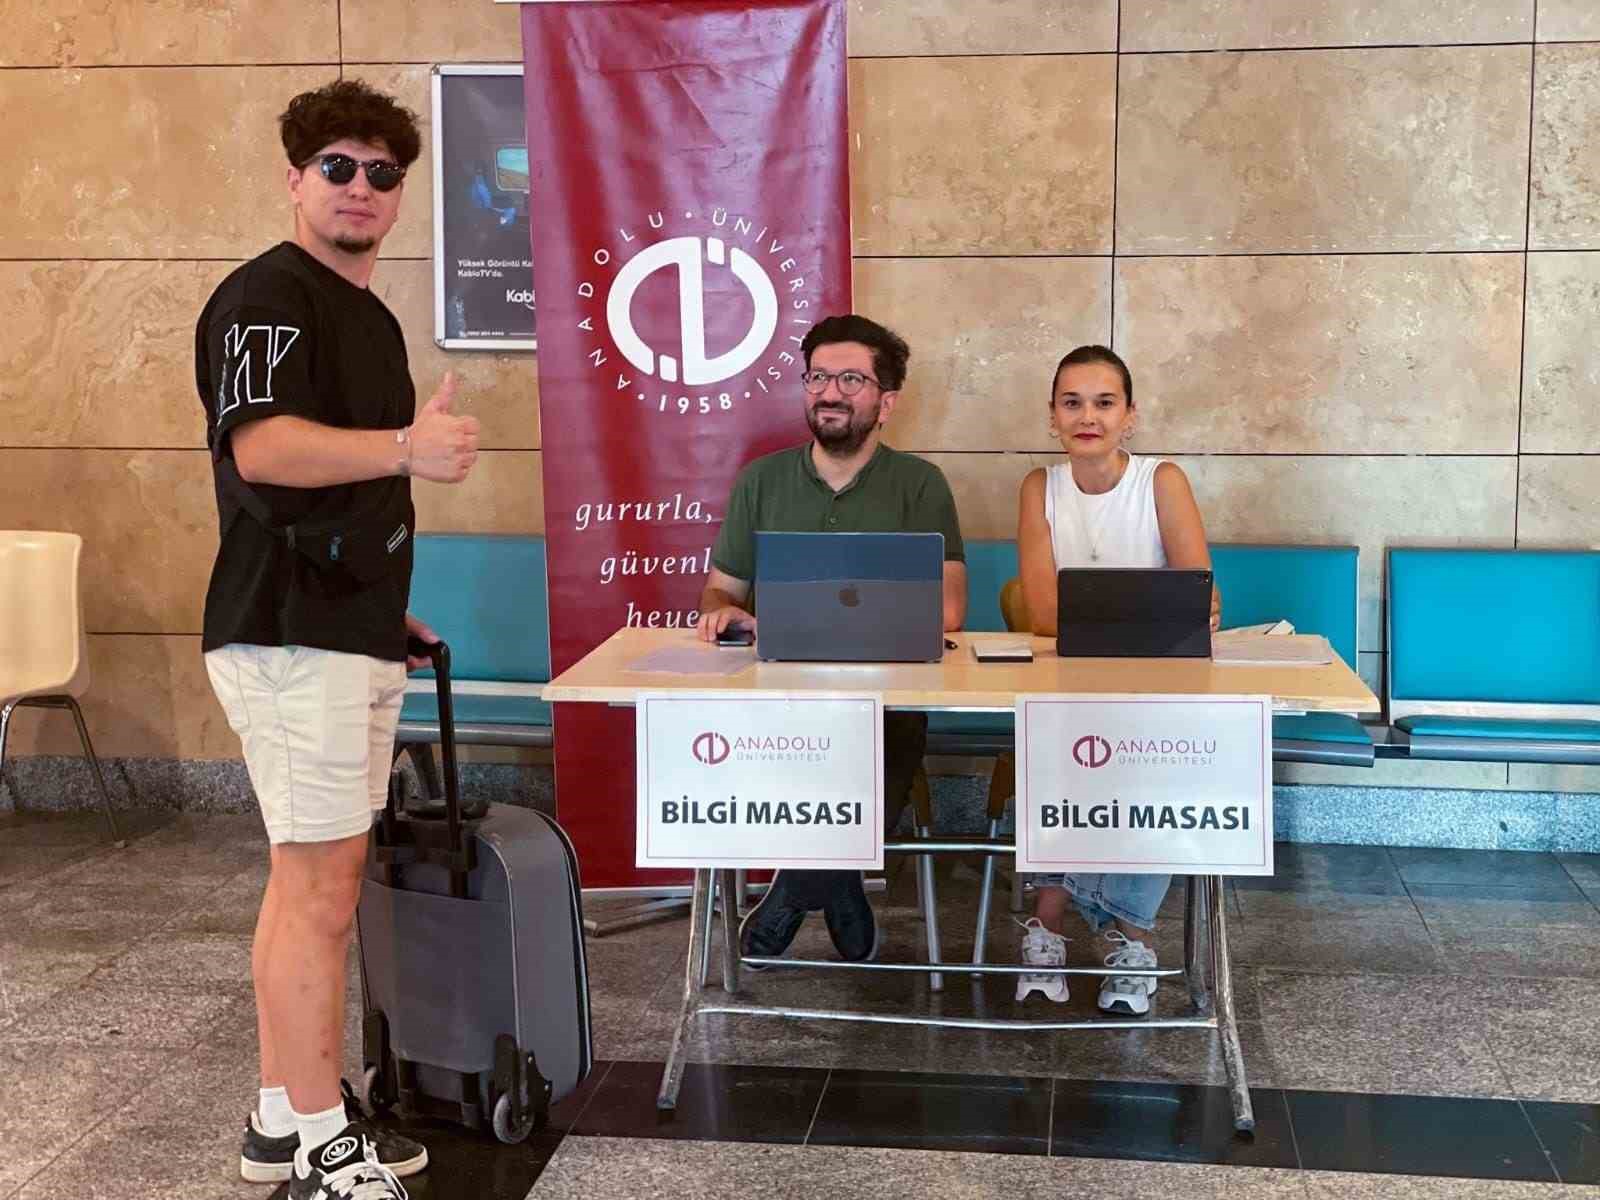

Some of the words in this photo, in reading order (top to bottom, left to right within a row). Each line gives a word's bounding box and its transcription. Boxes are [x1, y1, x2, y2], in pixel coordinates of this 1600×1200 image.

[457, 259, 486, 268] Yüksek
[487, 259, 521, 268] Görüntü
[577, 211, 664, 390] ANADOLU
[659, 393, 732, 414] 1958
[575, 493, 713, 531] gururla,
[600, 547, 712, 585] güvenl
[734, 736, 831, 751] ANADOLU
[1115, 739, 1217, 754] ANADOLU
[661, 795, 737, 824] BİLGİ
[746, 801, 862, 825] MASASI
[1041, 798, 1119, 828] BİLGİ
[1128, 804, 1250, 830] MASASI
